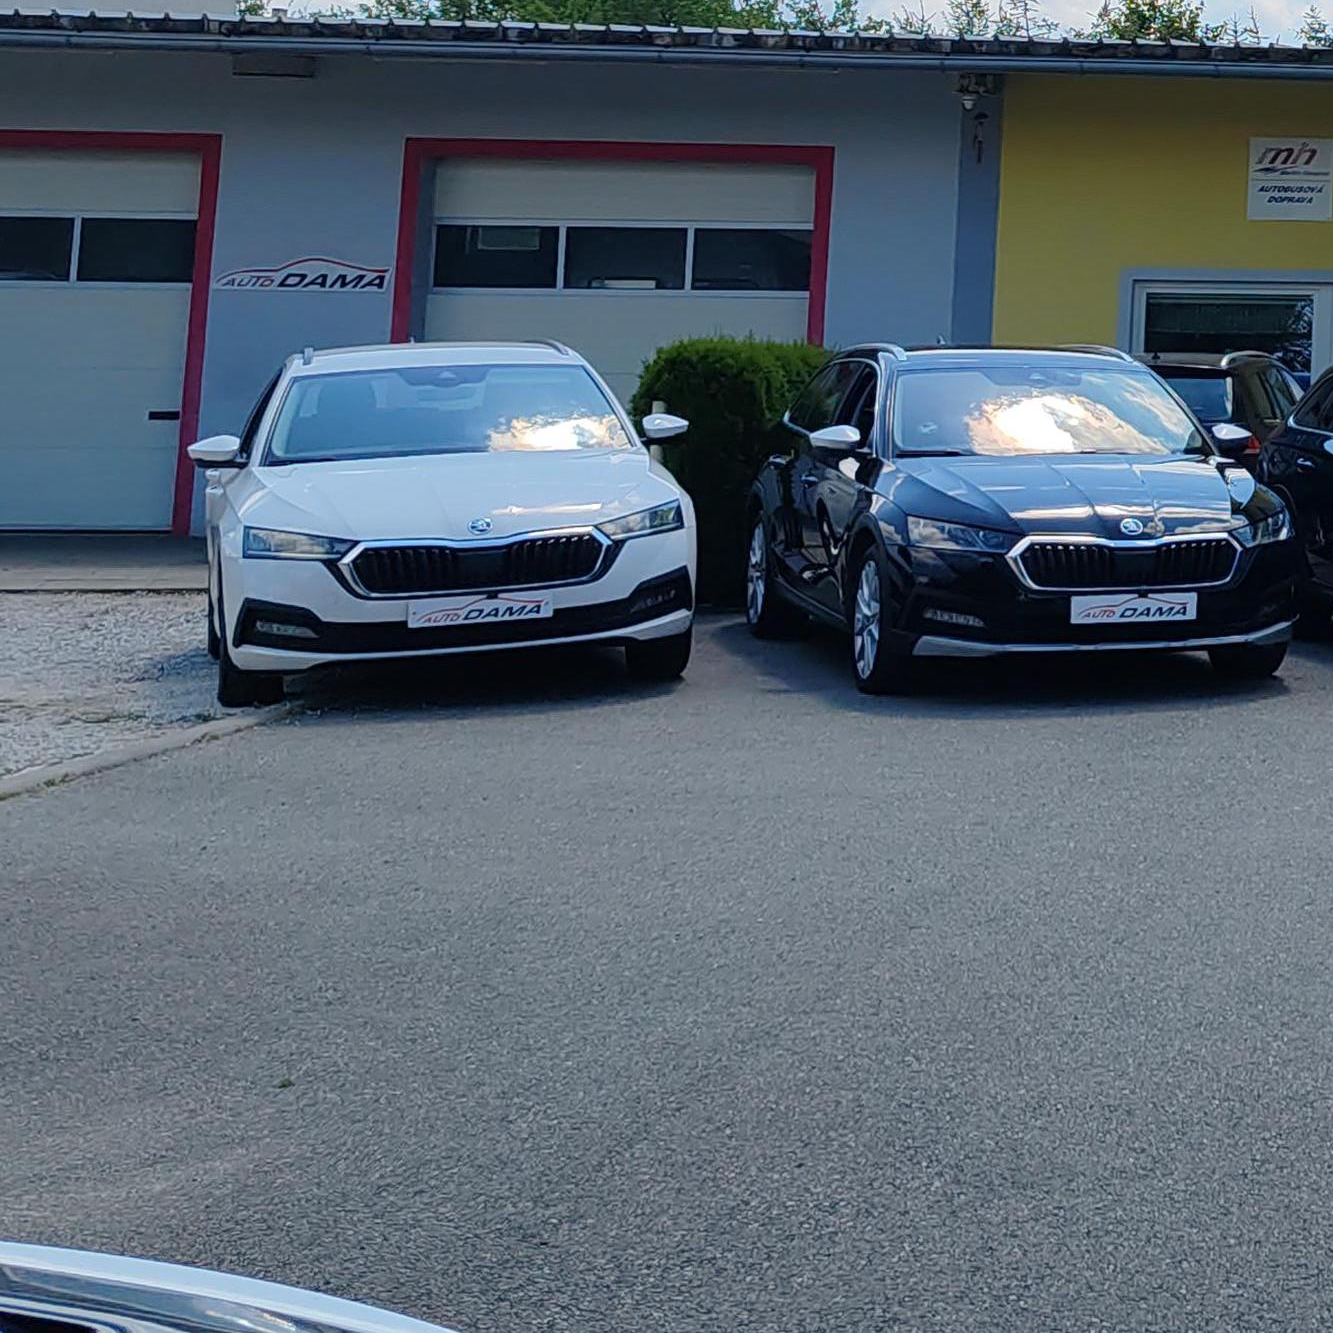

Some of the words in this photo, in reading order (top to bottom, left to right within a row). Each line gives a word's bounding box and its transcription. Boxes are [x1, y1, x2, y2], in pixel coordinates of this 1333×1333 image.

[221, 275, 276, 288] AUTO
[276, 273, 386, 289] DAMA
[423, 614, 462, 624] AUTO
[463, 604, 543, 621] DAMA
[1081, 609, 1116, 619] AUTO
[1119, 606, 1188, 619] DAMA
